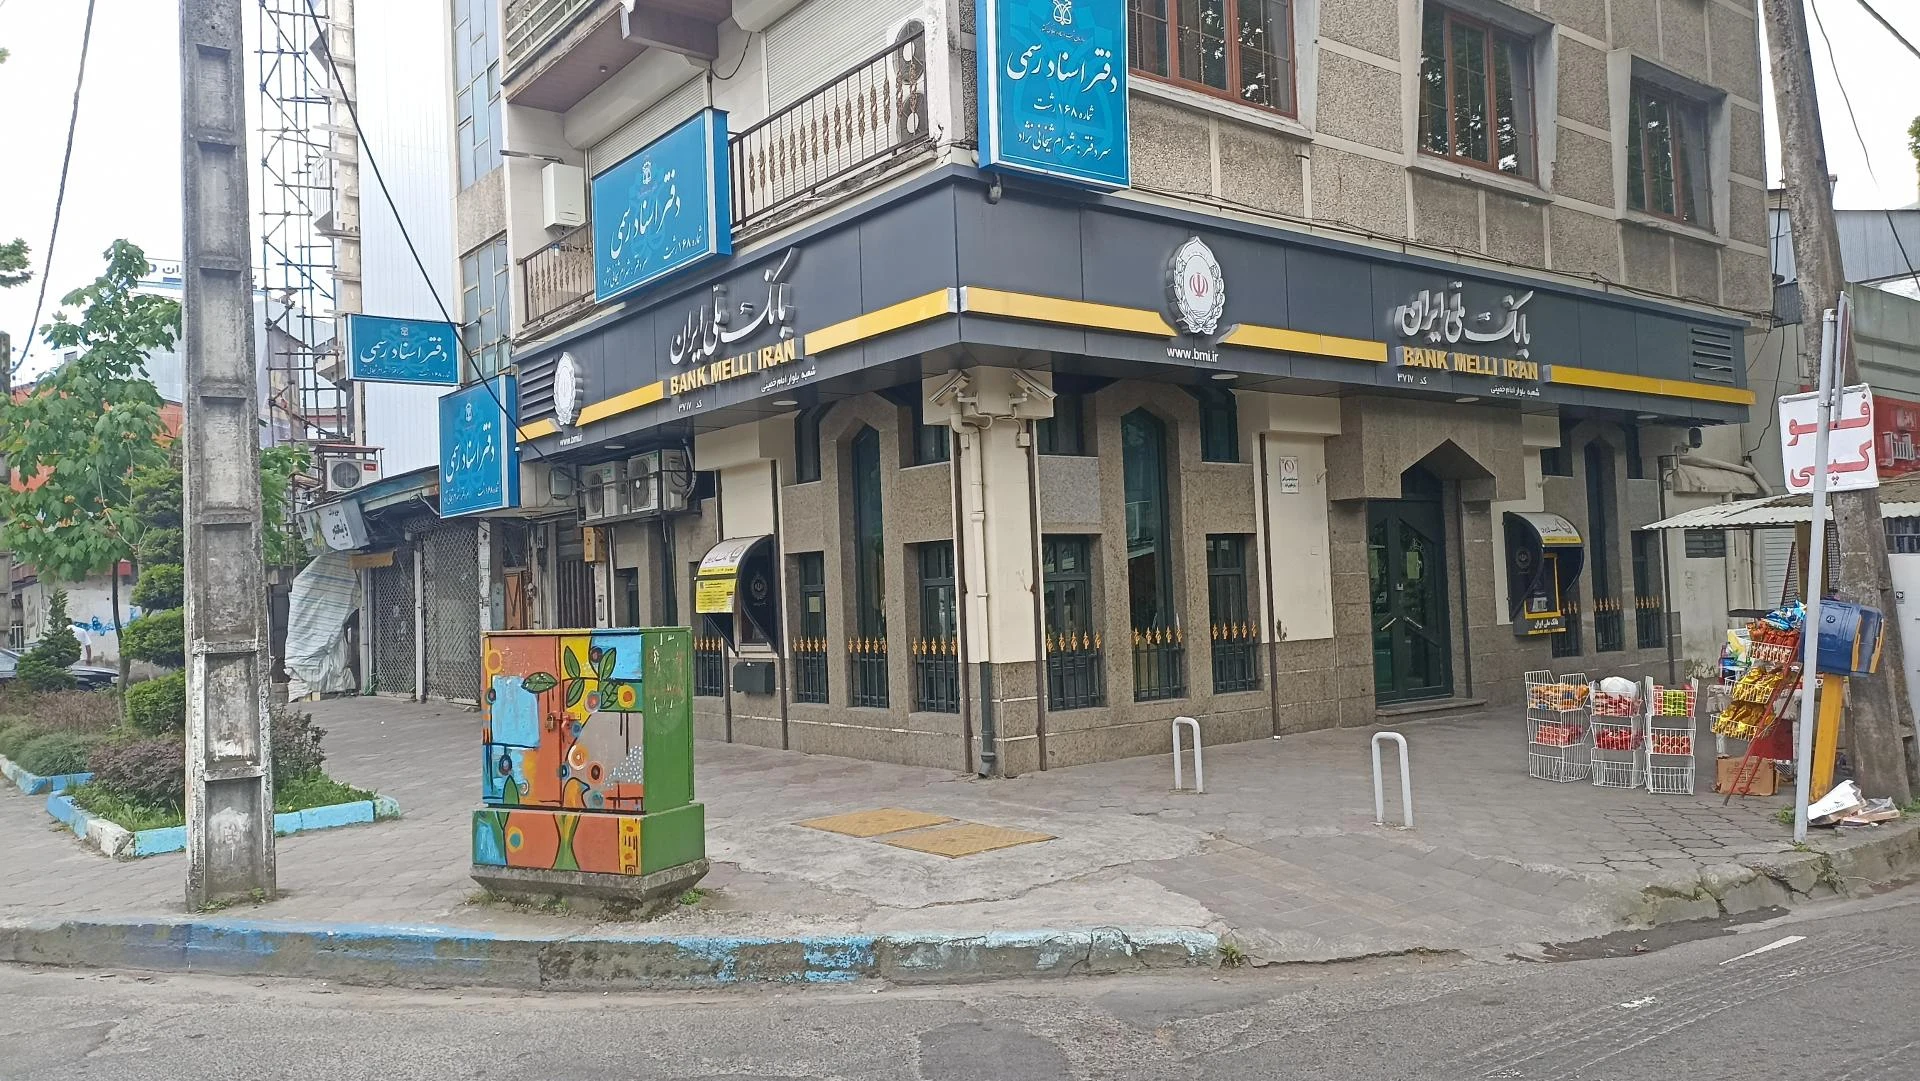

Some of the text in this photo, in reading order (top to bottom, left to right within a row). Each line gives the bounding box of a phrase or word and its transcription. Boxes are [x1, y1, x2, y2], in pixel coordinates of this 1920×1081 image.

[1007, 44, 1118, 93] دفتر اسناد رسمی
[1033, 93, 1094, 121] شماره ۱۶۸ رشت
[1054, 132, 1076, 155] شهرام
[611, 169, 681, 259] دفتر اسناد رسمی
[663, 235, 678, 260] رشت
[679, 238, 691, 252] ۱۶۸
[670, 247, 795, 365] بانک ملی ایران
[1397, 281, 1534, 360] بانک ملی ایران
[360, 336, 447, 364] دفتر اسناد رسمی
[1166, 347, 1219, 363] www.bmi.ir
[1402, 346, 1538, 381] BANK MELLI IRAN
[670, 337, 796, 396] BANK MELLI IRAN
[761, 365, 817, 393] شعبه بلوار امام خمینی
[1396, 373, 1428, 385] کد ۳۷۱۷
[1527, 386, 1540, 397] شعبه
[445, 422, 495, 483] دفتر اسناد رسمی
